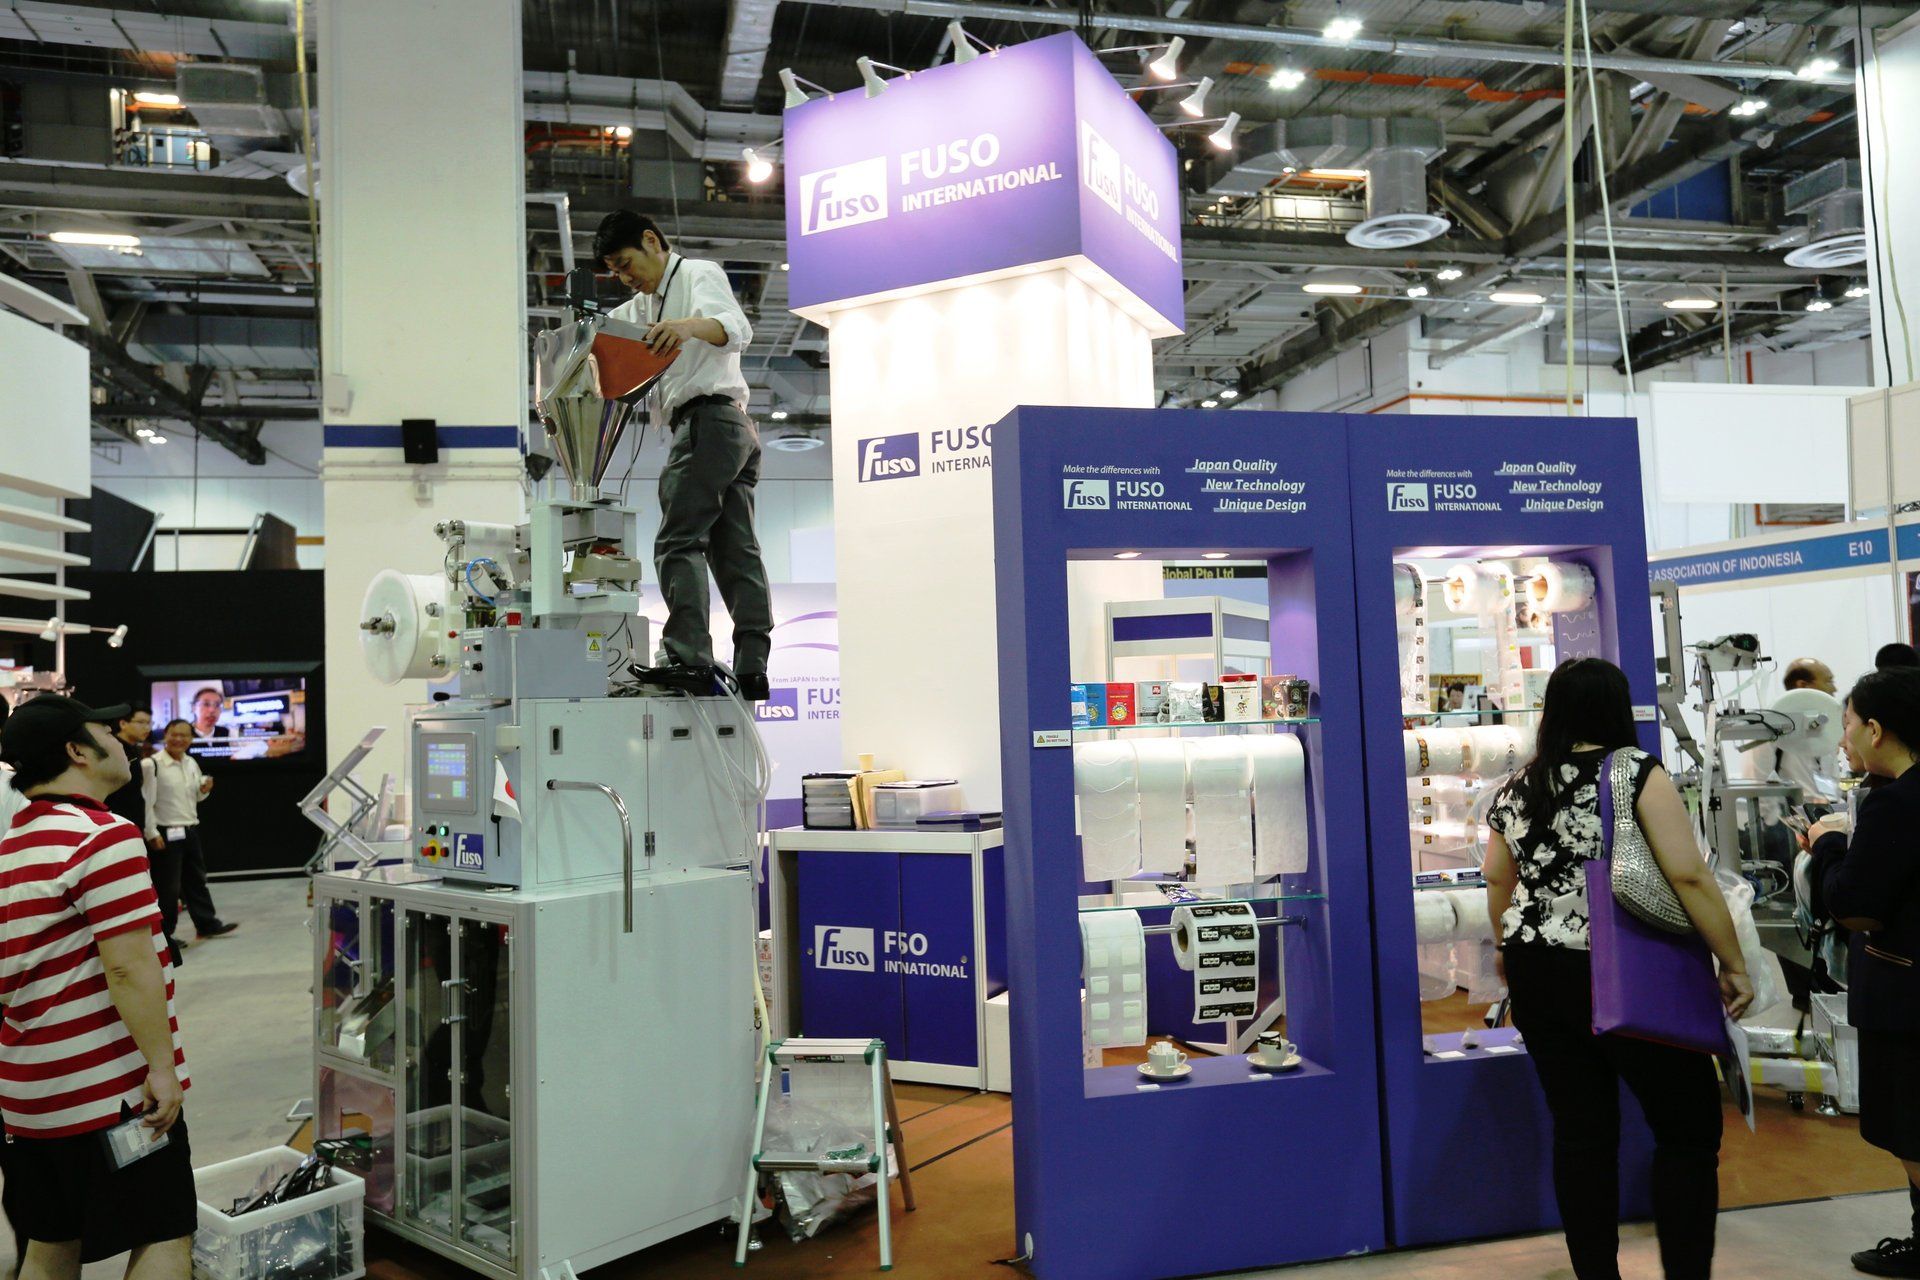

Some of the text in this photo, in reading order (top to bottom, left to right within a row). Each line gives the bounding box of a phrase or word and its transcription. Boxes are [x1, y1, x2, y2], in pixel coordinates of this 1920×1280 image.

[900, 132, 1000, 185] FUSO
[902, 162, 1062, 213] INTERNATIONAL
[1123, 163, 1159, 221] FUSO
[1125, 204, 1178, 264] INTERNATIONAL
[1063, 464, 1161, 475] Make the differences with
[1191, 459, 1278, 474] Japan Quality
[1386, 469, 1473, 478] Make the differences with
[1500, 461, 1577, 476] Japan Quality
[1116, 481, 1165, 498] FUSO
[1205, 478, 1306, 494] New Technology
[1434, 484, 1477, 499] FUSO
[1513, 480, 1602, 494] New Technology
[1116, 500, 1193, 512] INTERNATIONAL
[1219, 498, 1307, 514] Unique Design
[1434, 502, 1503, 512] INTERNATIONAL
[1525, 498, 1604, 513] Unique Design
[1849, 540, 1873, 557] E10
[1653, 561, 1720, 582] ASSOCIATION
[1722, 558, 1737, 573] OF
[1740, 550, 1803, 572] INDONESIA
